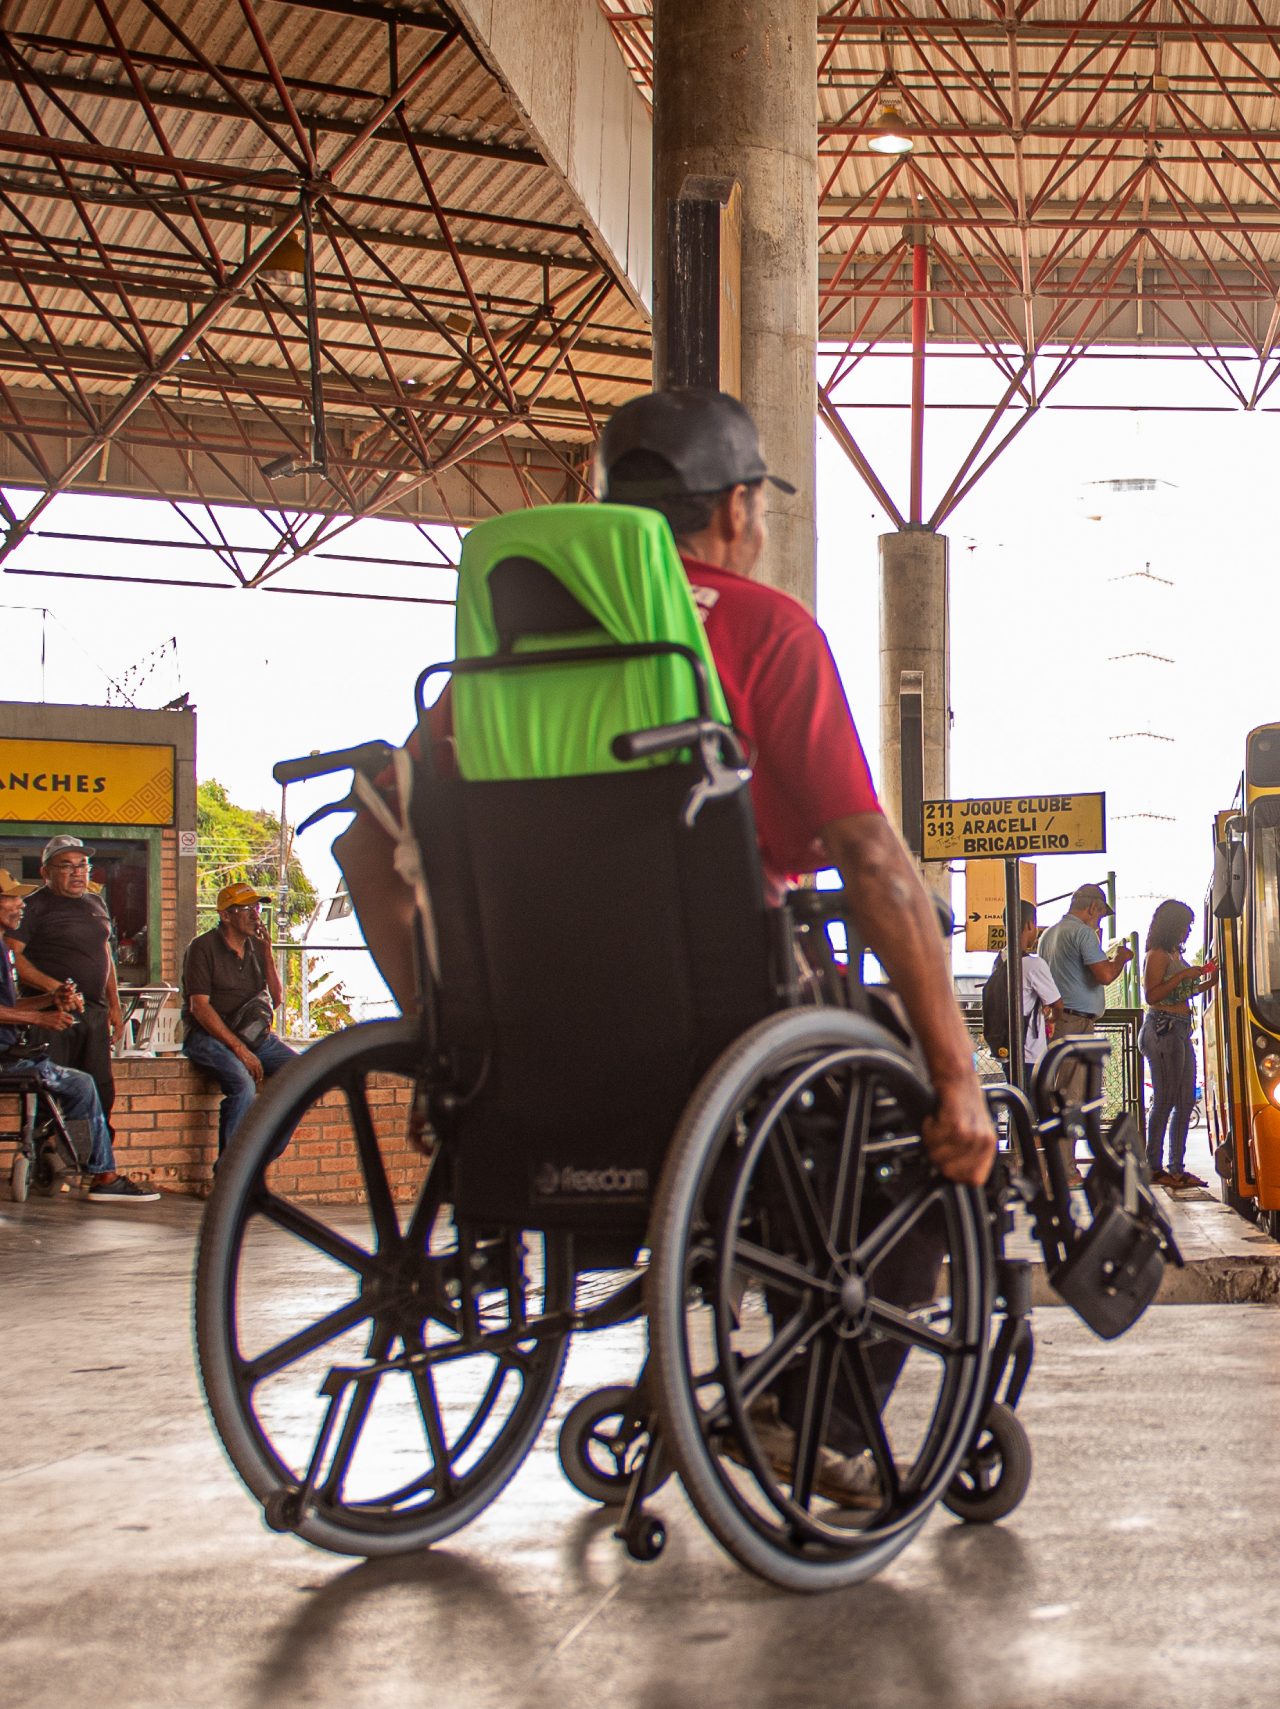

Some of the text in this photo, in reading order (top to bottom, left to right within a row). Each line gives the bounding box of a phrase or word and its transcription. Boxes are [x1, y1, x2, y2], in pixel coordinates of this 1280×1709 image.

[925, 797, 1072, 819] 211 JOQUE CLUBE
[927, 822, 954, 837] 313
[962, 817, 1037, 835] ARACELI
[963, 834, 1070, 853] BRIGADEIRO
[991, 928, 1006, 938] 20
